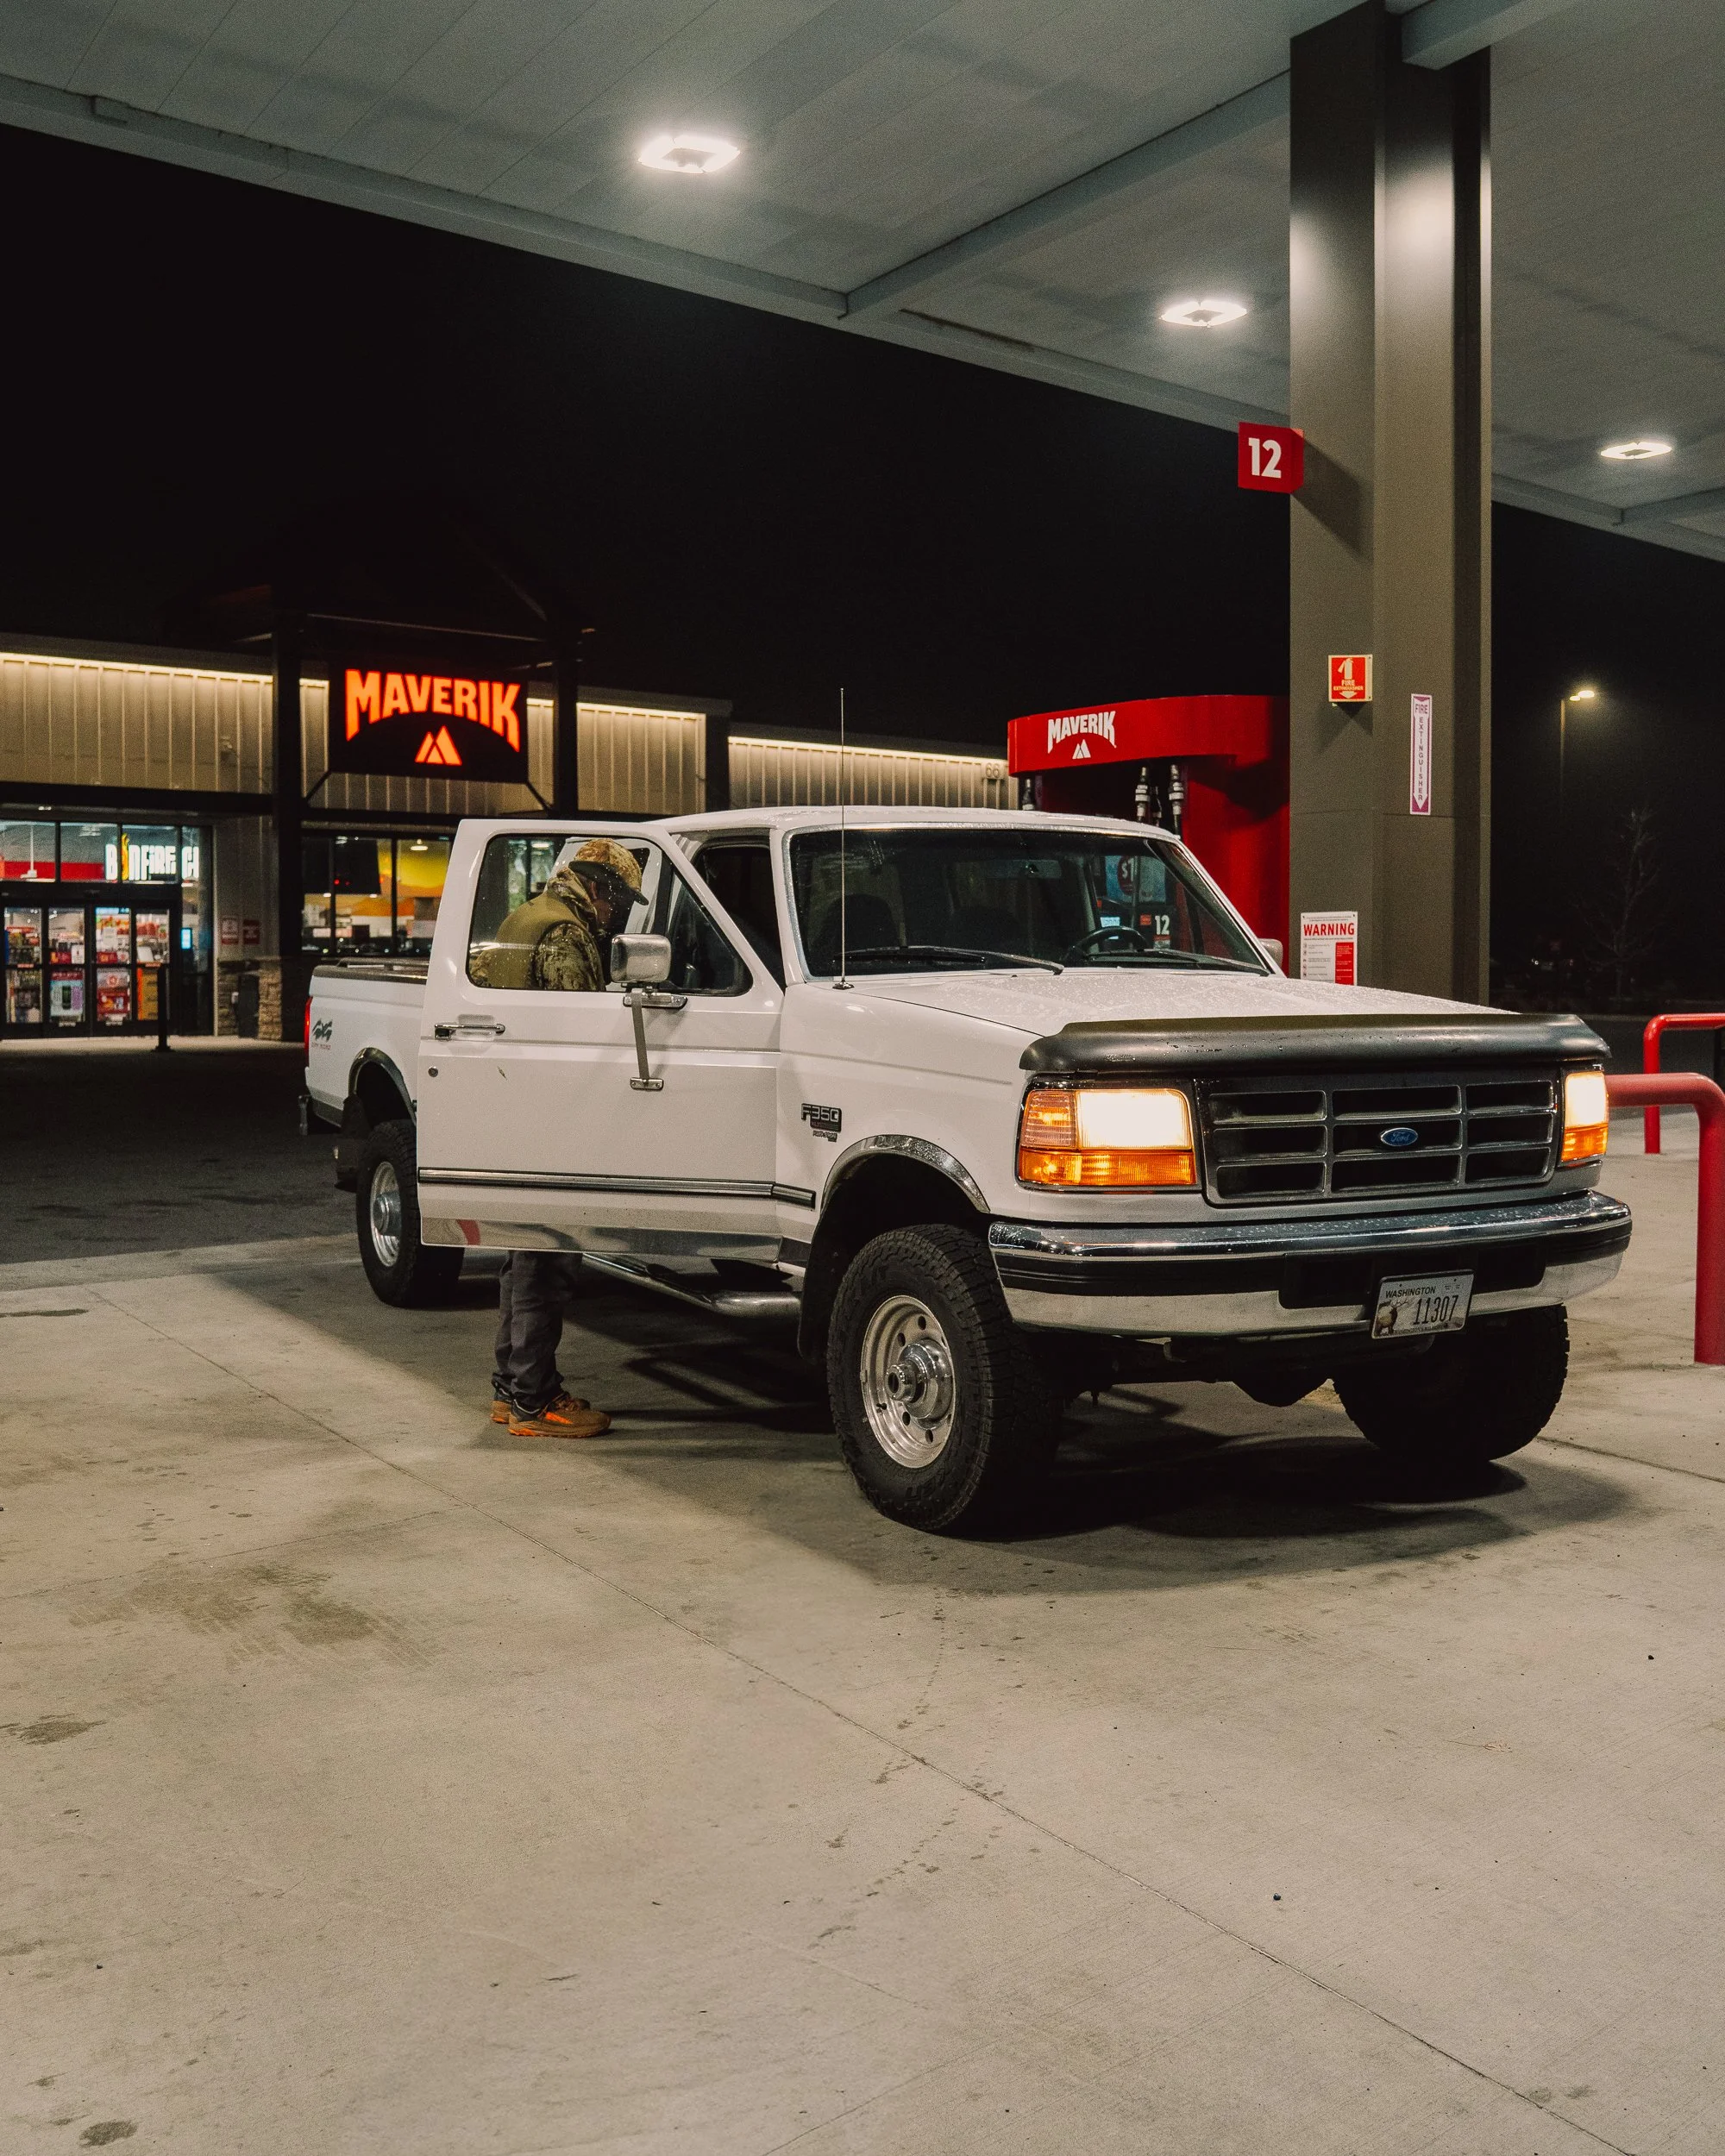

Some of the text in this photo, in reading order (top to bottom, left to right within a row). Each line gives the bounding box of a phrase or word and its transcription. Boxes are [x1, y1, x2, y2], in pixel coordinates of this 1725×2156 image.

[1248, 437, 1282, 479] 12
[346, 669, 520, 752] MAVERIK
[1415, 704, 1428, 714] FIRE
[1047, 710, 1117, 754] MAVERIK
[1155, 915, 1170, 935] 12
[1303, 923, 1355, 937] WARNING
[801, 1104, 839, 1122] F350
[1385, 1286, 1436, 1298] WASHINGTON
[1413, 1294, 1459, 1325] 11307
